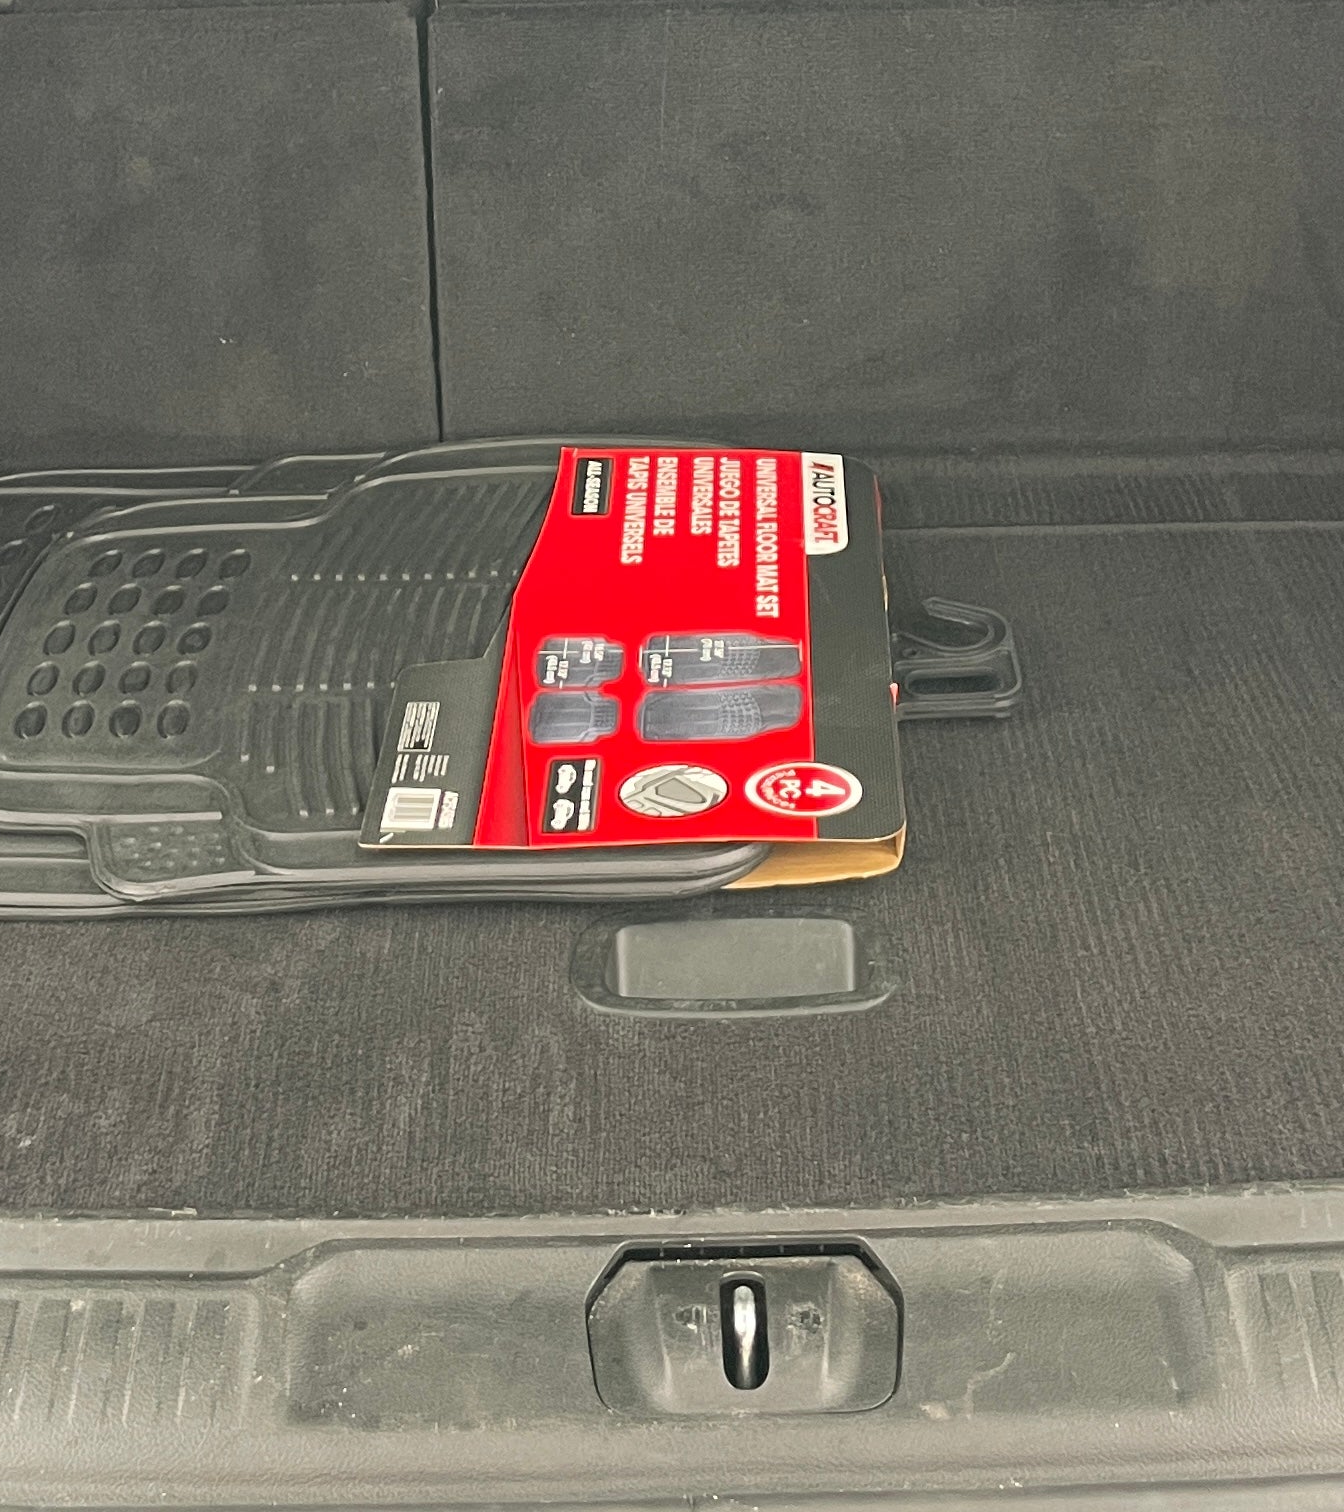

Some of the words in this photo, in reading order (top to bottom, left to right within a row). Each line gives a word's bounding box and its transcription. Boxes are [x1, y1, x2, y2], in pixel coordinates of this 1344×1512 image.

[583, 460, 603, 513] ALL-SEASON
[627, 456, 651, 490] TAPIS
[654, 457, 678, 517] ENSEMBLE
[719, 457, 741, 499] JUEGO
[756, 458, 778, 520] UNIVERSAL
[691, 456, 714, 536] UNIVERSALES
[719, 500, 741, 517] DE
[812, 470, 839, 544] AUTOCRAFT
[620, 492, 647, 565] UNIVERSELS
[653, 519, 675, 536] DE
[717, 519, 741, 568] TAPETES
[756, 522, 778, 563] FLOOR
[756, 564, 779, 593] MAT
[756, 595, 780, 618] SET
[779, 779, 802, 799] PC
[805, 780, 846, 798] 4
